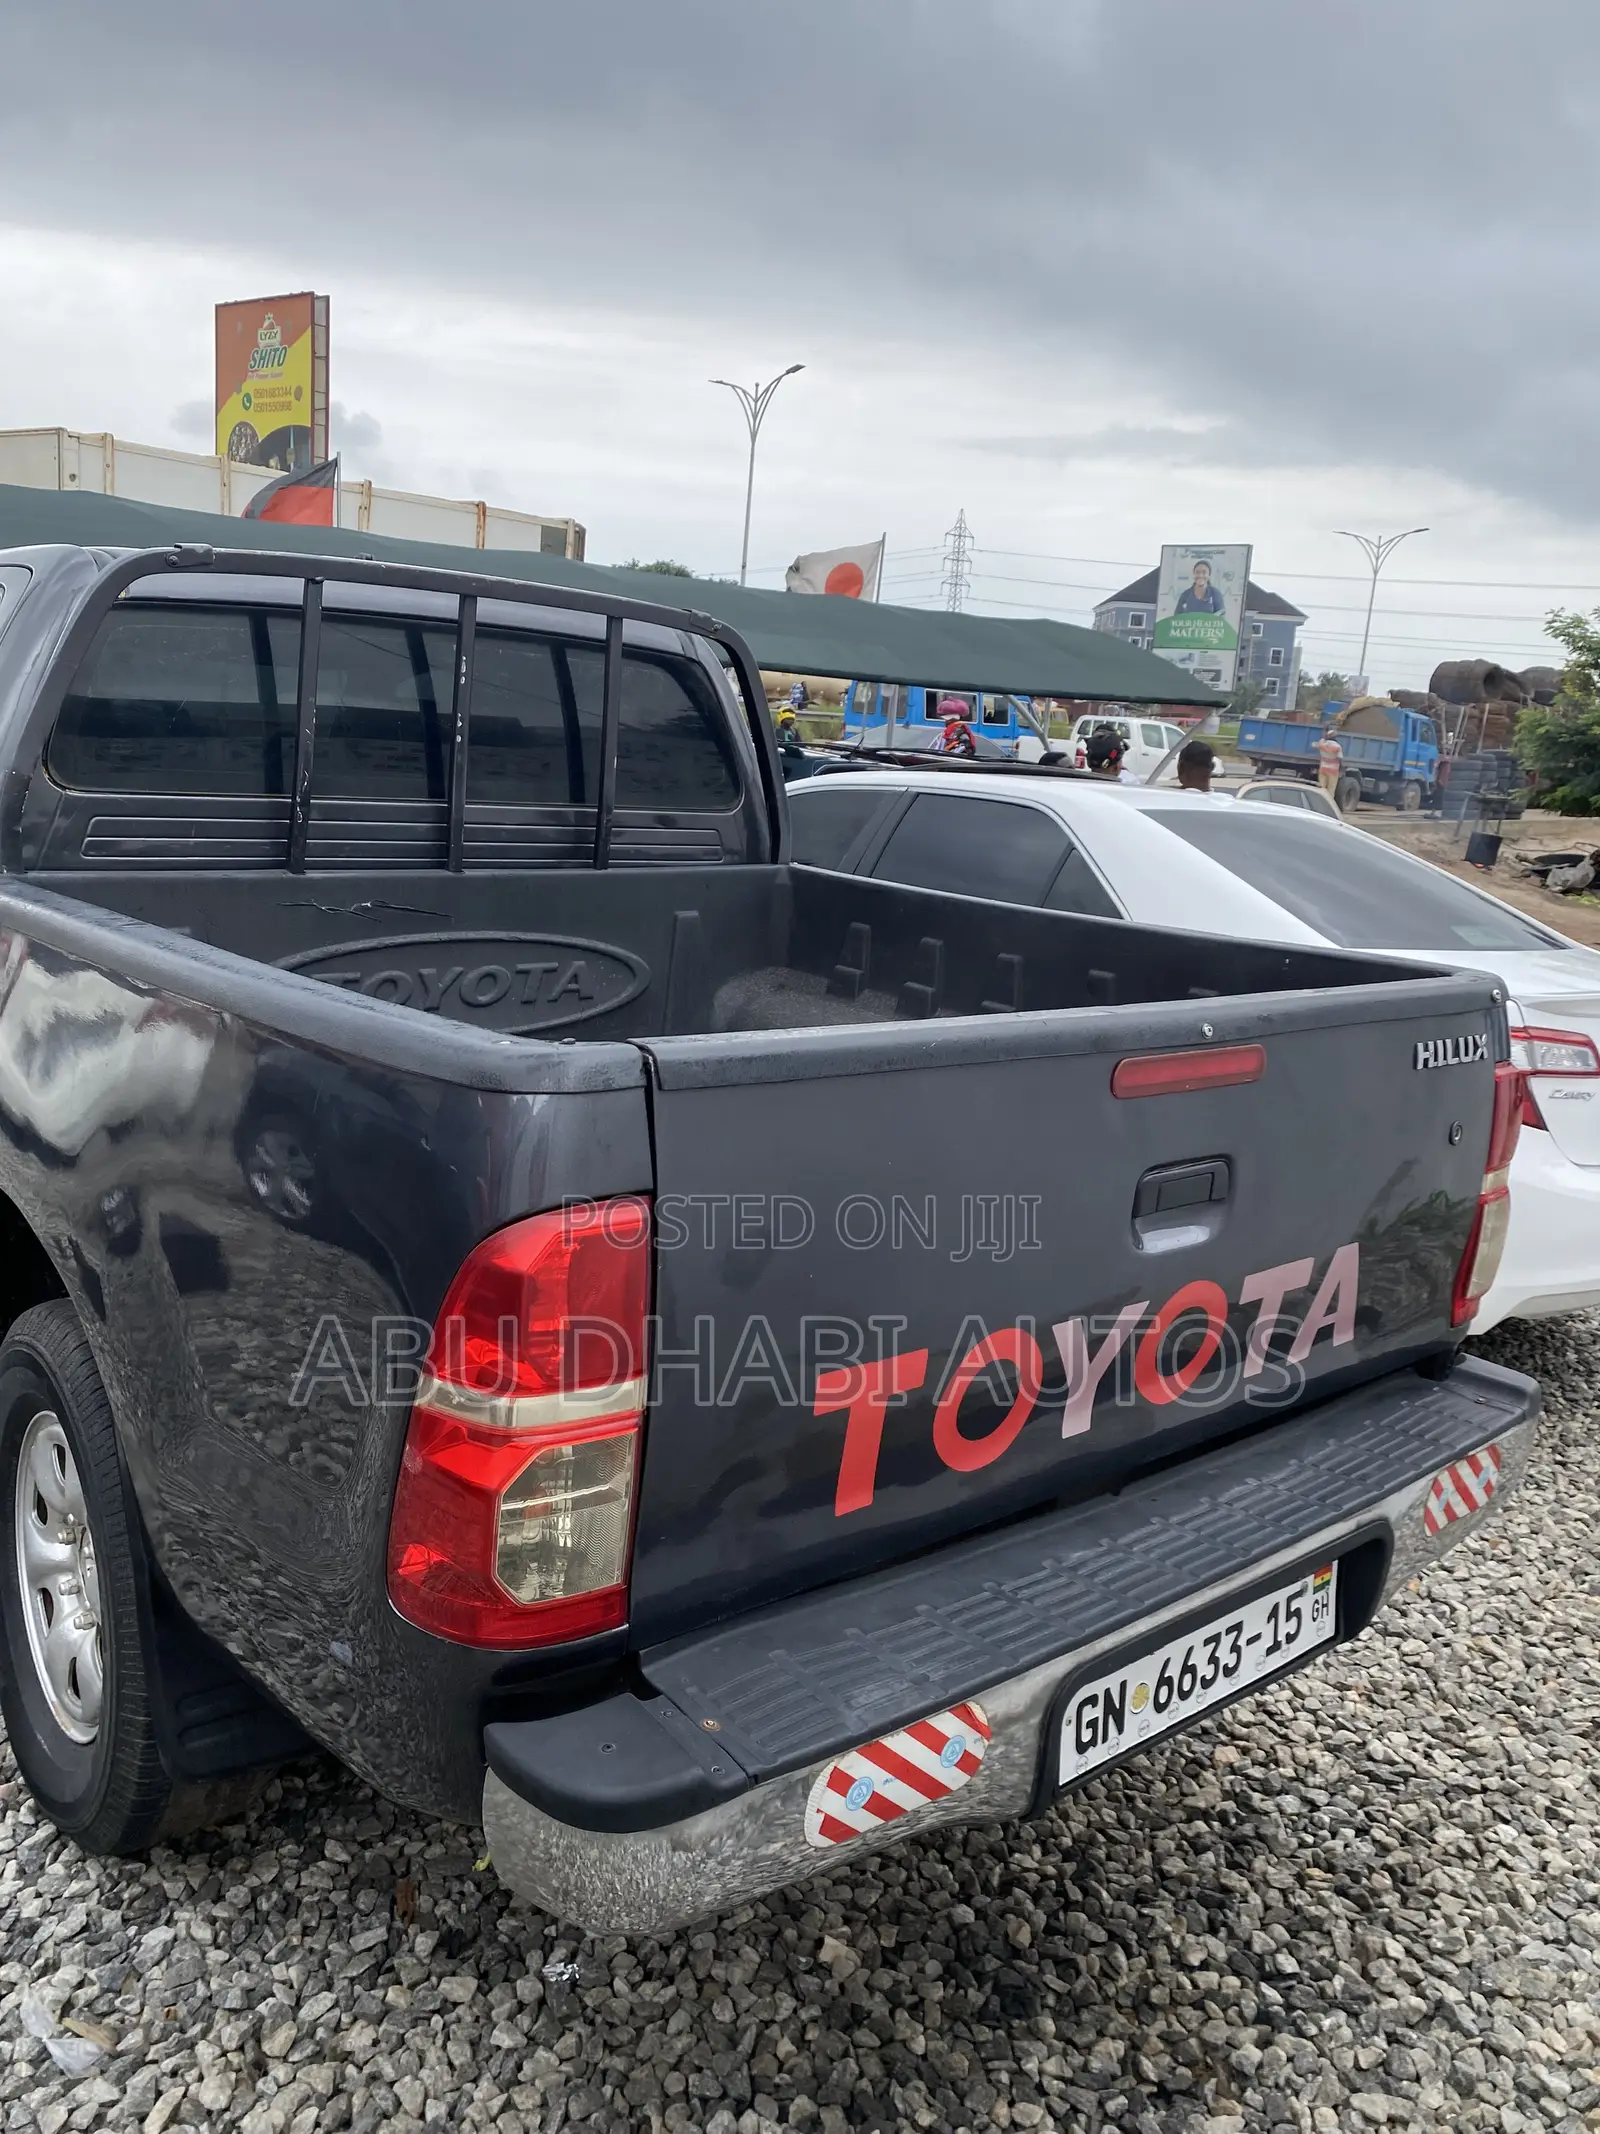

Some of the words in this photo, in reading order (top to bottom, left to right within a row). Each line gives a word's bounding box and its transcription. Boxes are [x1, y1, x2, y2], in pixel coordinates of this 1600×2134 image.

[248, 345, 288, 370] SHITO
[1169, 628, 1225, 638] MATTERS!
[1171, 620, 1191, 628] YOUR
[1192, 620, 1224, 629] HEALTH
[1413, 1033, 1489, 1070] HILUX
[813, 1241, 1360, 1517] TOYOTA
[1311, 1590, 1330, 1623] GH
[1075, 1679, 1128, 1755] GN
[1153, 1589, 1304, 1714] 6633-15
